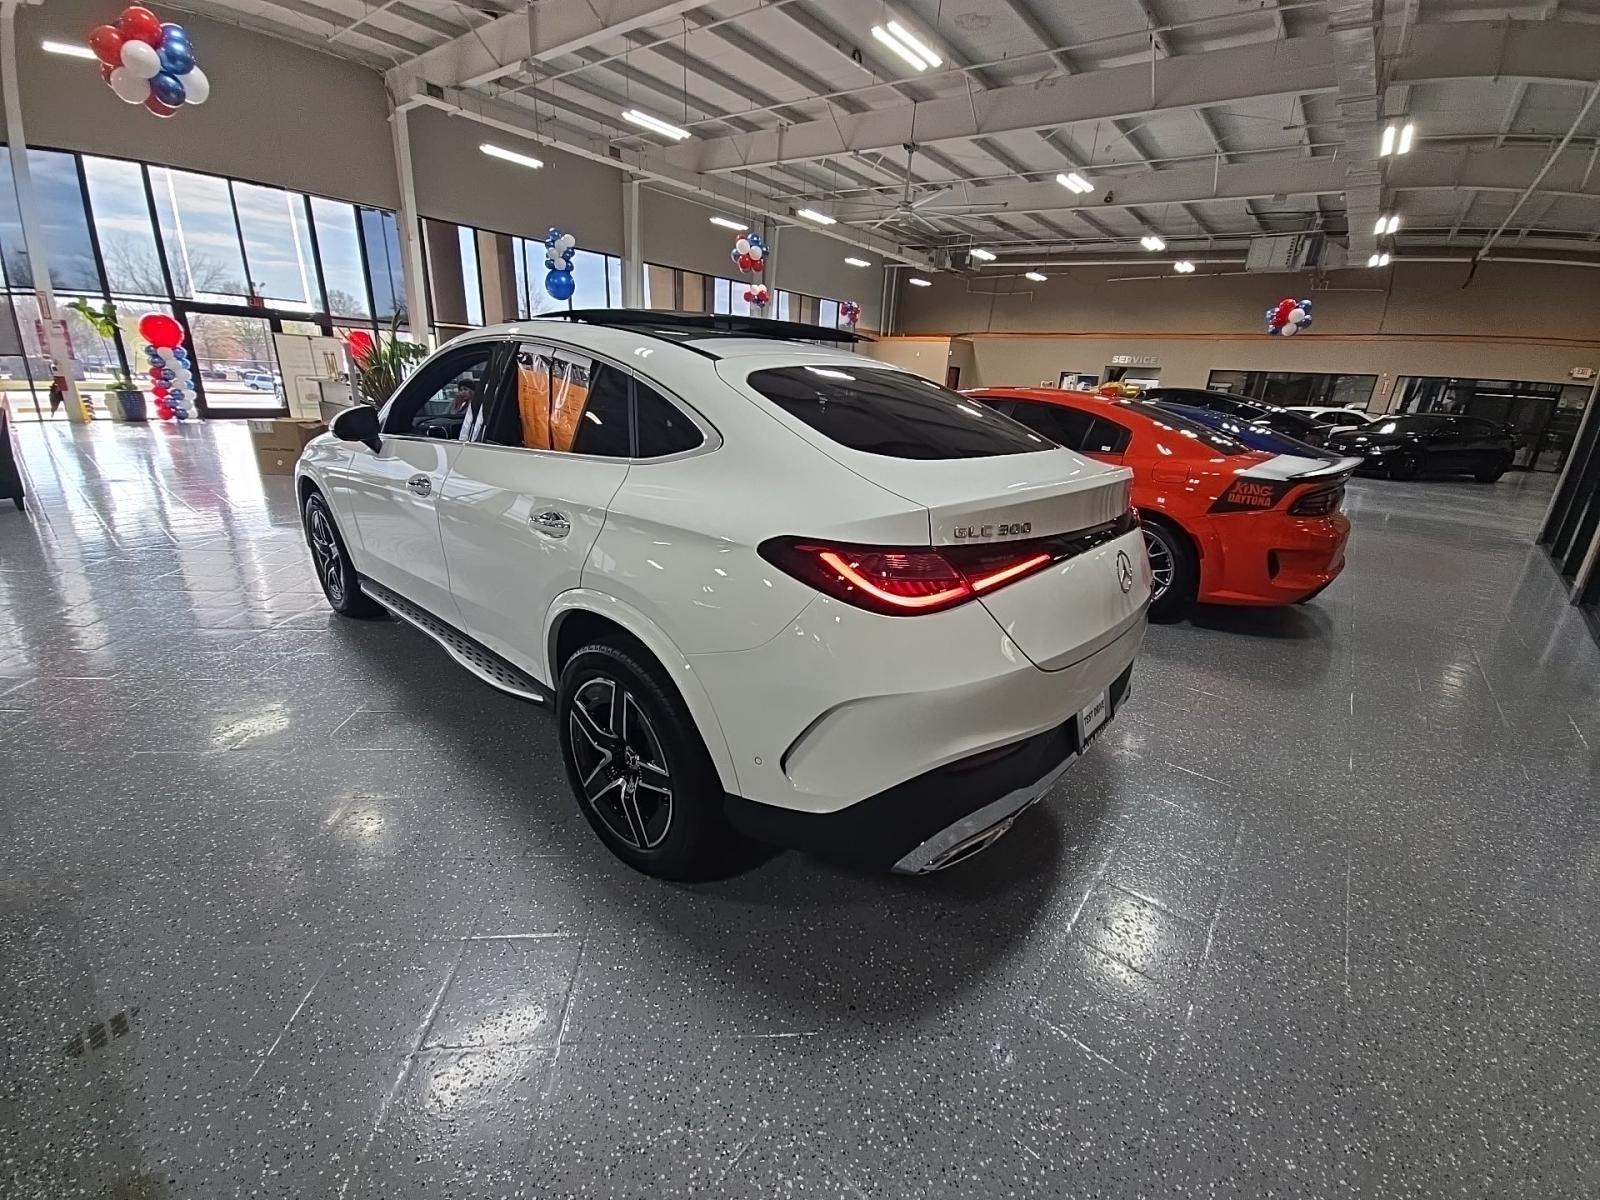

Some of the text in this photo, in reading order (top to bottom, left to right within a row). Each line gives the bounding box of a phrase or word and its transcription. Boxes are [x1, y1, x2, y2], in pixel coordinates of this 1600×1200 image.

[1112, 355, 1159, 364] SERVICE
[1227, 492, 1271, 507] DAYTONA
[954, 522, 1032, 539] GLC 300
